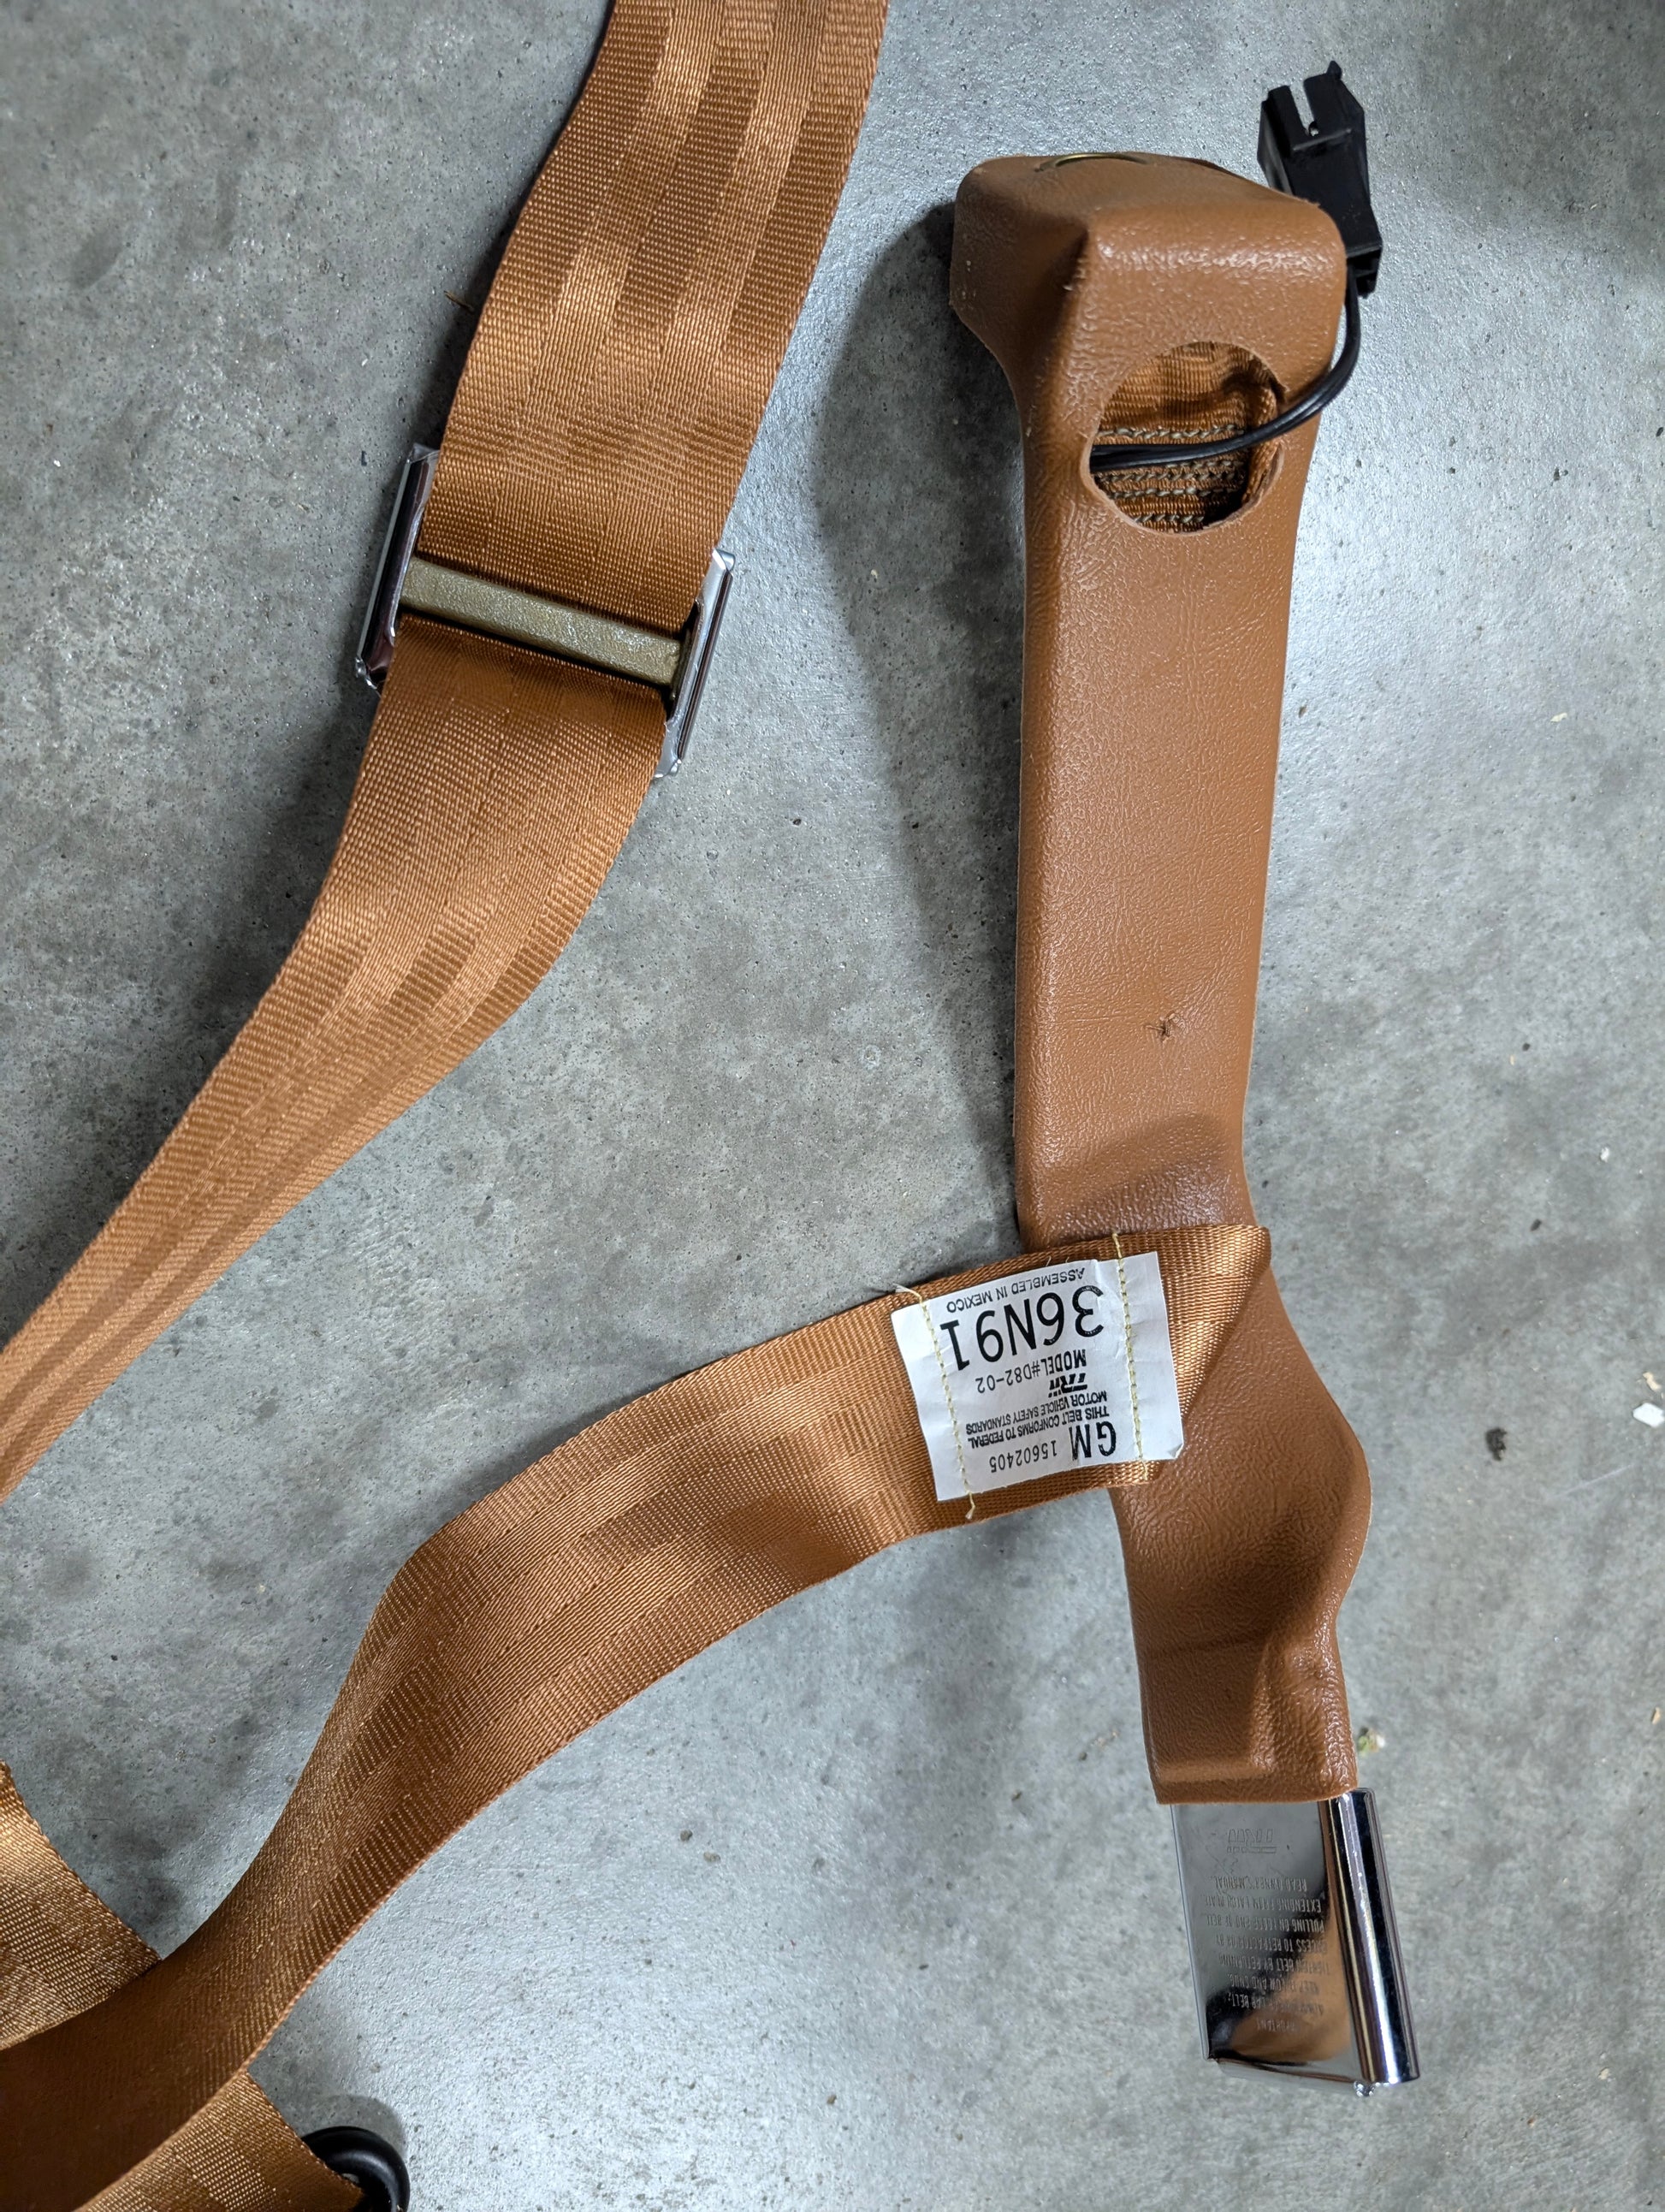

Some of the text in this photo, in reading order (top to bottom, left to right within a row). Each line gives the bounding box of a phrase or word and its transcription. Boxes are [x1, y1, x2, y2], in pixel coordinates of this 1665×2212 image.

[946, 1267, 1085, 1314] ASSEMBLED IN MEXICO
[939, 1285, 1104, 1371] 36N91
[975, 1349, 1087, 1393] MODEL#D82-02
[966, 1391, 1107, 1435] MOTOR VEHICLE SAFETY STANDARDS
[968, 1406, 1109, 1449] THIS BELT CONFORMS TO FEDERAL
[989, 1421, 1117, 1474] GM 15602405
[1285, 1877, 1307, 1892] READ
[1277, 1897, 1321, 1913] EXTENDING
[1279, 1918, 1289, 1932] ON
[1291, 1918, 1324, 1934] PULLING
[1283, 1937, 1294, 1952] TO
[1264, 1958, 1273, 1972] BY
[1276, 1958, 1294, 1972] BELT
[1251, 1976, 1267, 1990] AND
